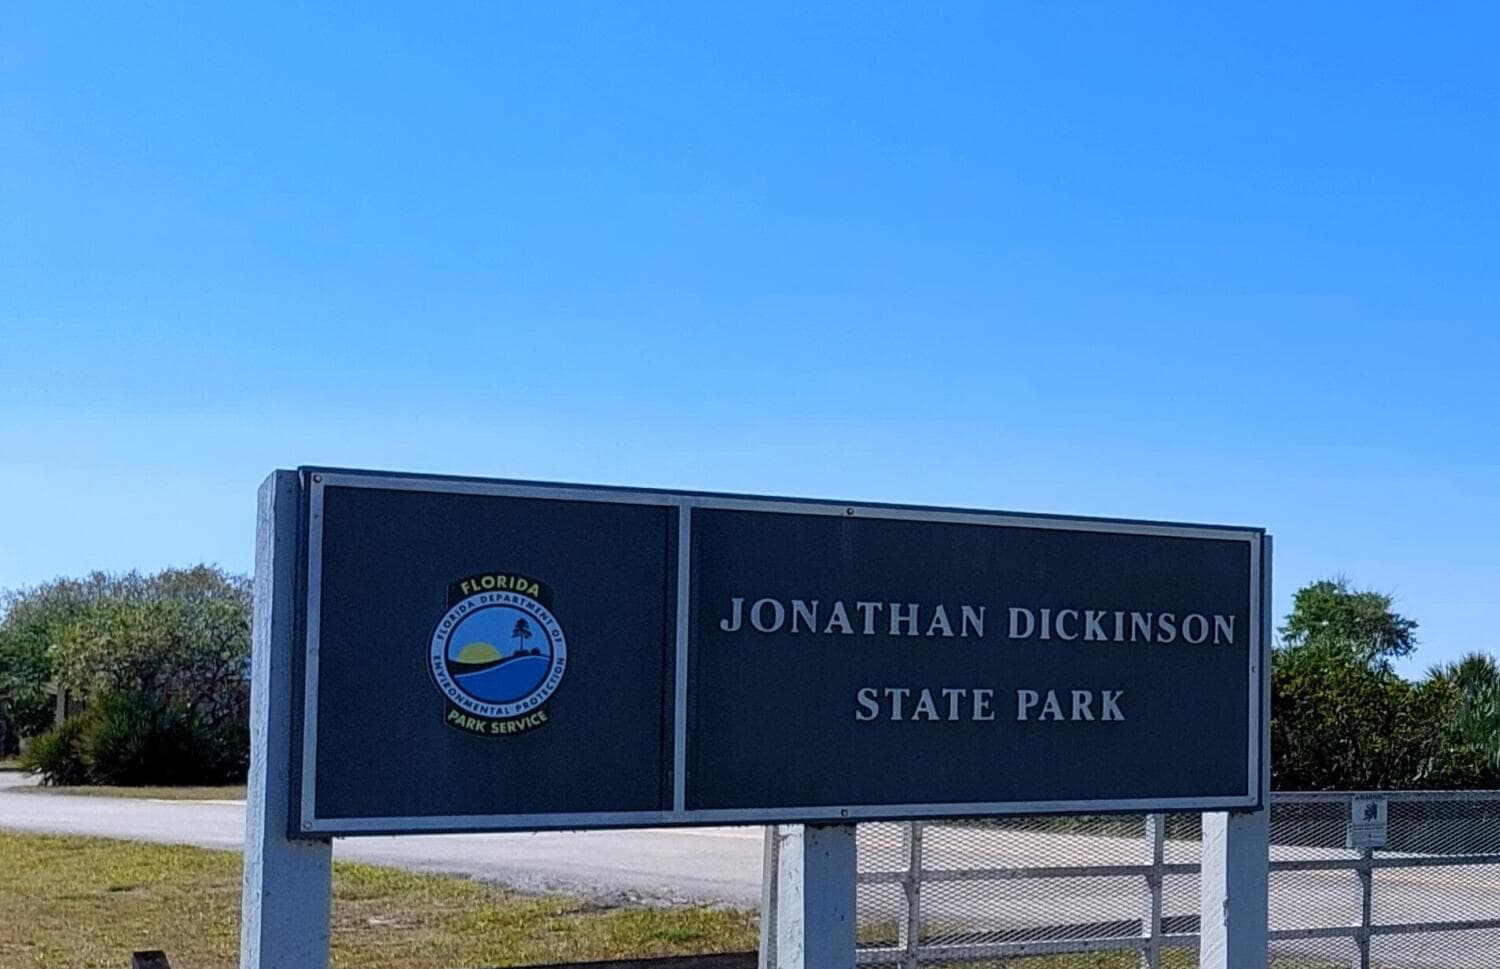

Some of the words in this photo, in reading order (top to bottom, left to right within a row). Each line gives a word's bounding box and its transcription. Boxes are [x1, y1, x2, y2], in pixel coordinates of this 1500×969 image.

[460, 575, 540, 597] FLORIDA
[437, 600, 475, 641] FLORIDA
[480, 593, 553, 626] DEPARTMENT
[551, 628, 563, 644] OF
[720, 598, 986, 637] JONATHAN
[1008, 607, 1236, 644] DICKINSON
[433, 655, 510, 715] ENVIRONMENTAL
[514, 657, 565, 713] PROTECTION
[855, 688, 995, 721] STATE
[1016, 689, 1126, 721] PARK
[447, 709, 486, 734] PARK
[490, 710, 549, 734] SERVICE
